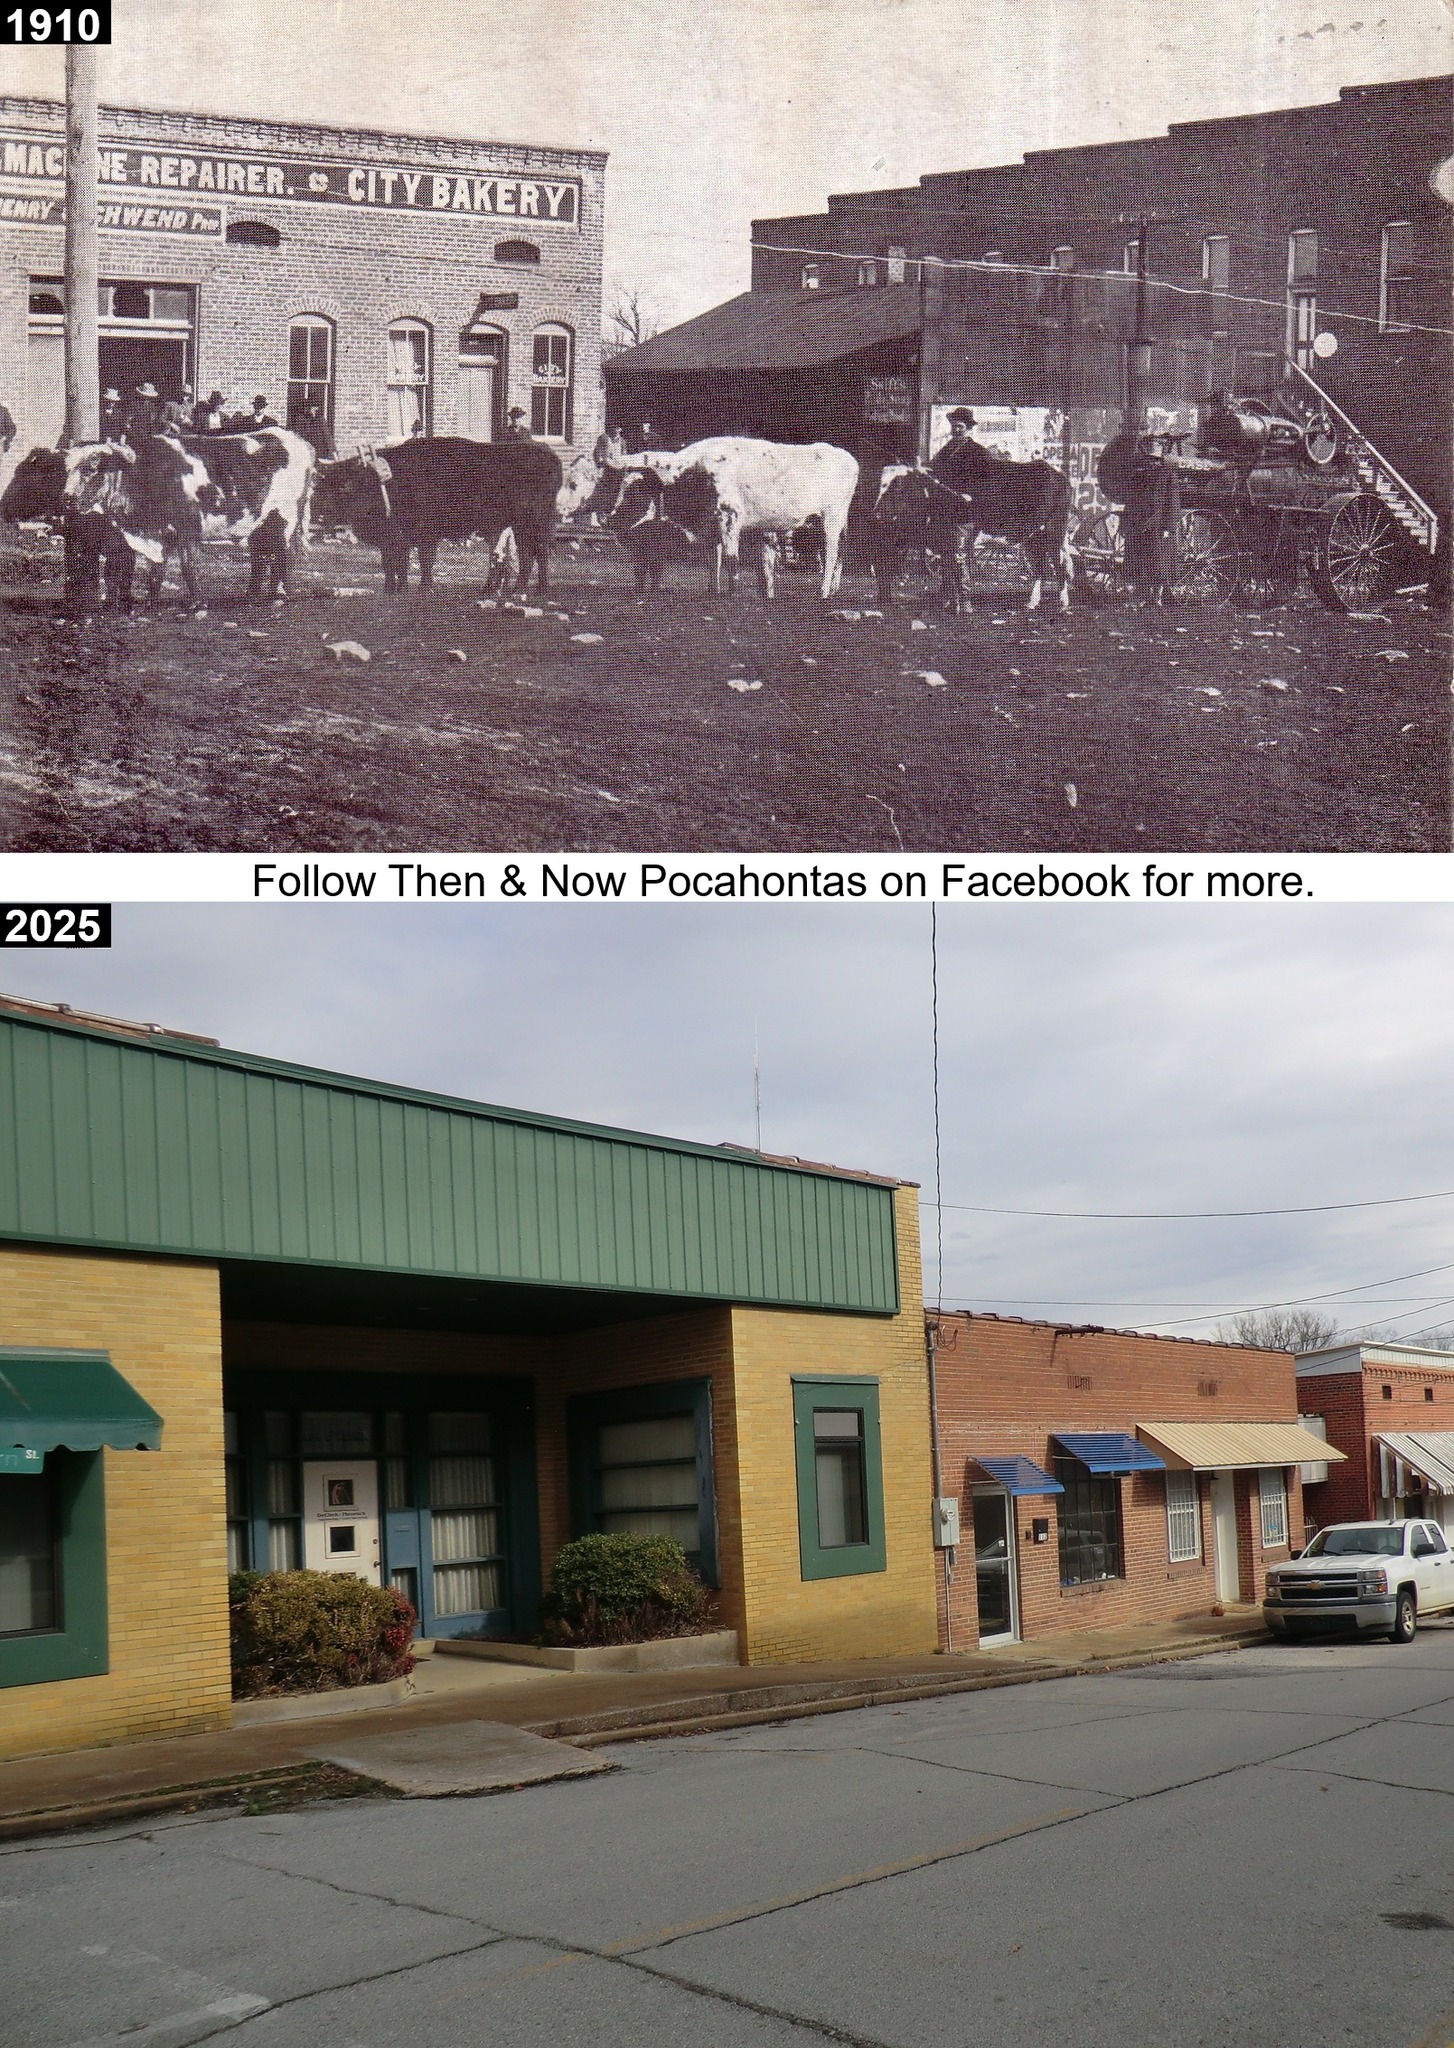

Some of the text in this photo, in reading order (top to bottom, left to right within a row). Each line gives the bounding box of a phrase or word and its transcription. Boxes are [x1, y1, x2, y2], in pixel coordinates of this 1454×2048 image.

[4, 142, 127, 181] MACNE
[141, 155, 294, 194] REPAIRER.
[348, 169, 423, 204] CITY
[432, 176, 568, 217] BAKERY
[0, 198, 55, 220] ENRY
